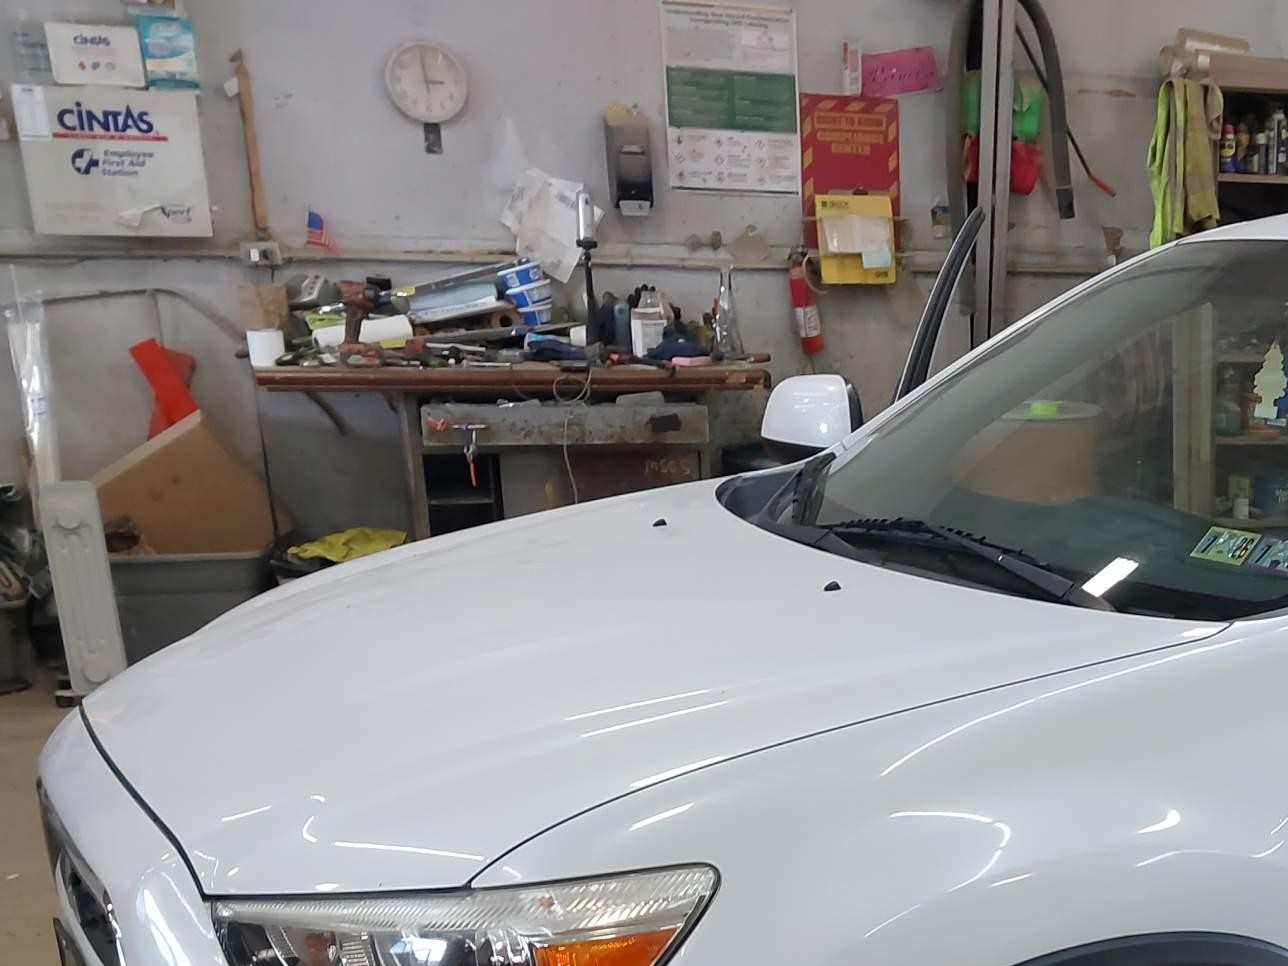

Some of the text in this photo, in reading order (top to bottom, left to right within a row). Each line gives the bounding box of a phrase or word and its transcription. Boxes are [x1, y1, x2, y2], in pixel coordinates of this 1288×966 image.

[57, 101, 154, 134] CINTAS
[103, 149, 154, 160] Employee
[101, 168, 138, 176] Station
